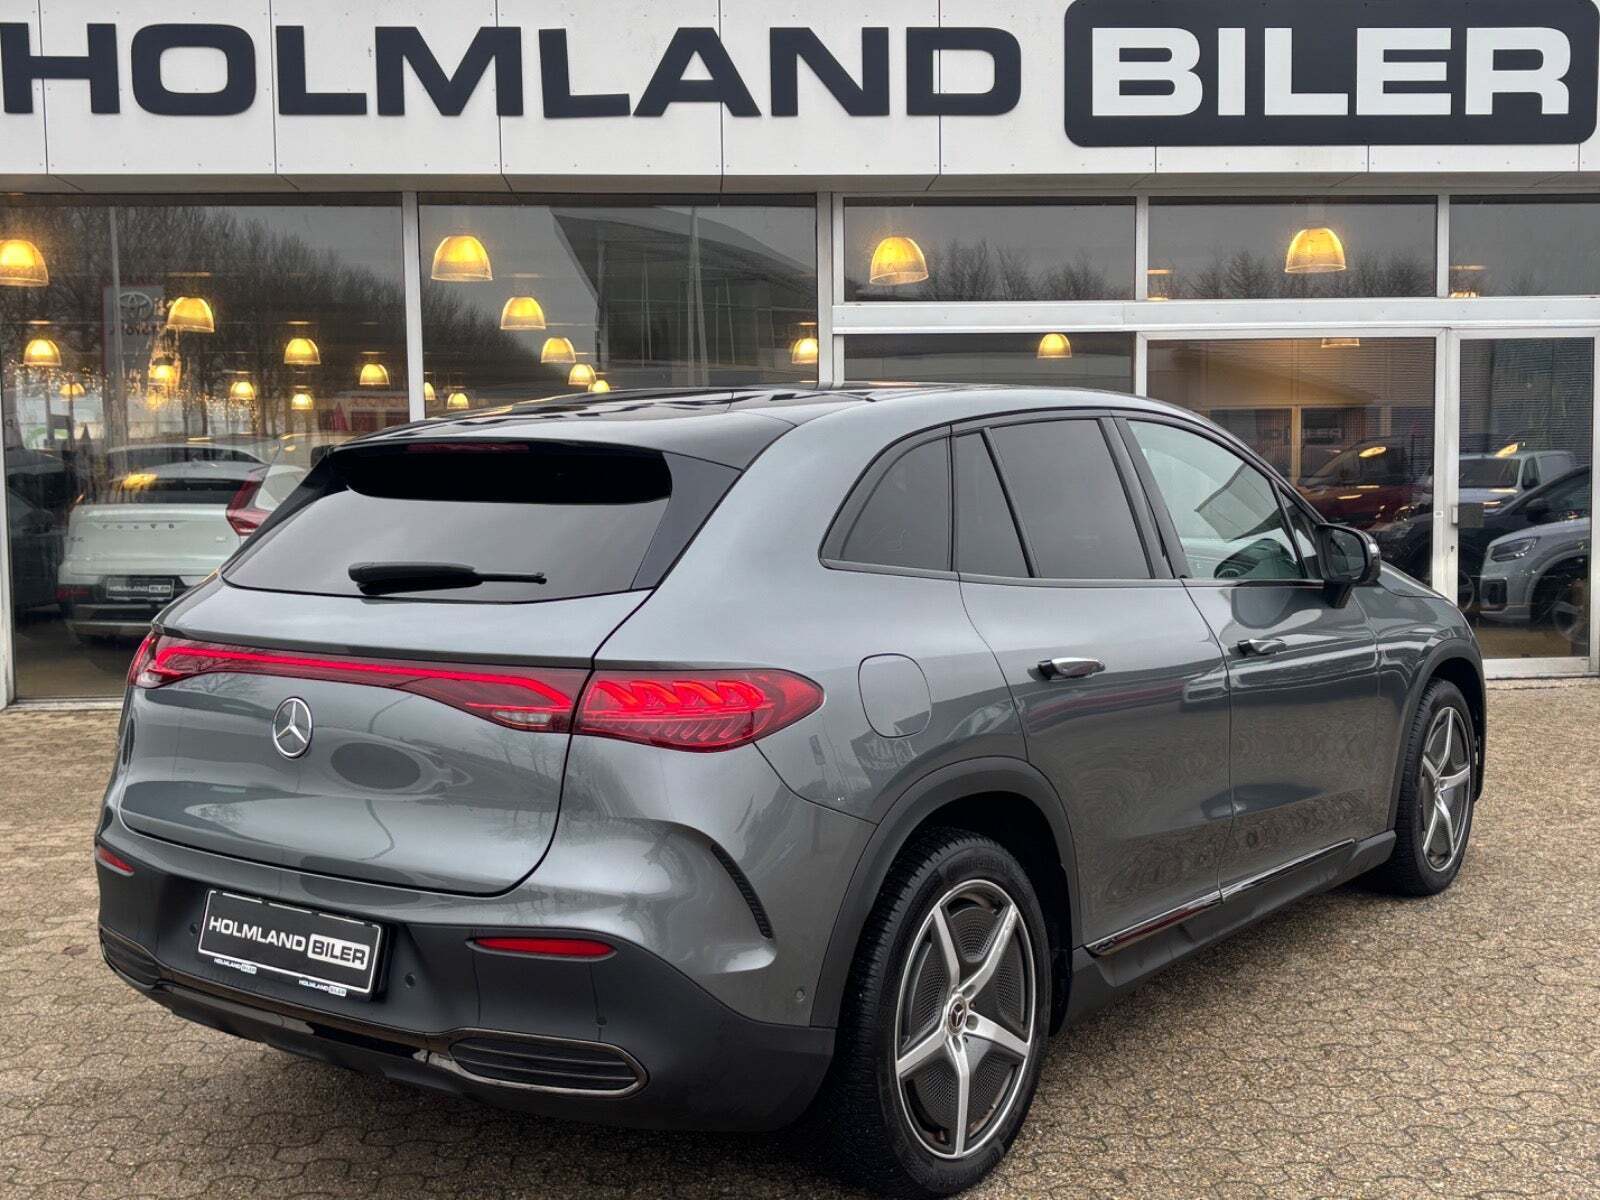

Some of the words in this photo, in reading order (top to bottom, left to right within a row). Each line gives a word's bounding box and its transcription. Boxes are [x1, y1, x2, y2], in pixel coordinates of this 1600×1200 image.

[0, 23, 1021, 118] HOLMLAND
[1092, 27, 1570, 116] BILER
[208, 916, 306, 951] HOLMLAND
[311, 939, 366, 966] BILER
